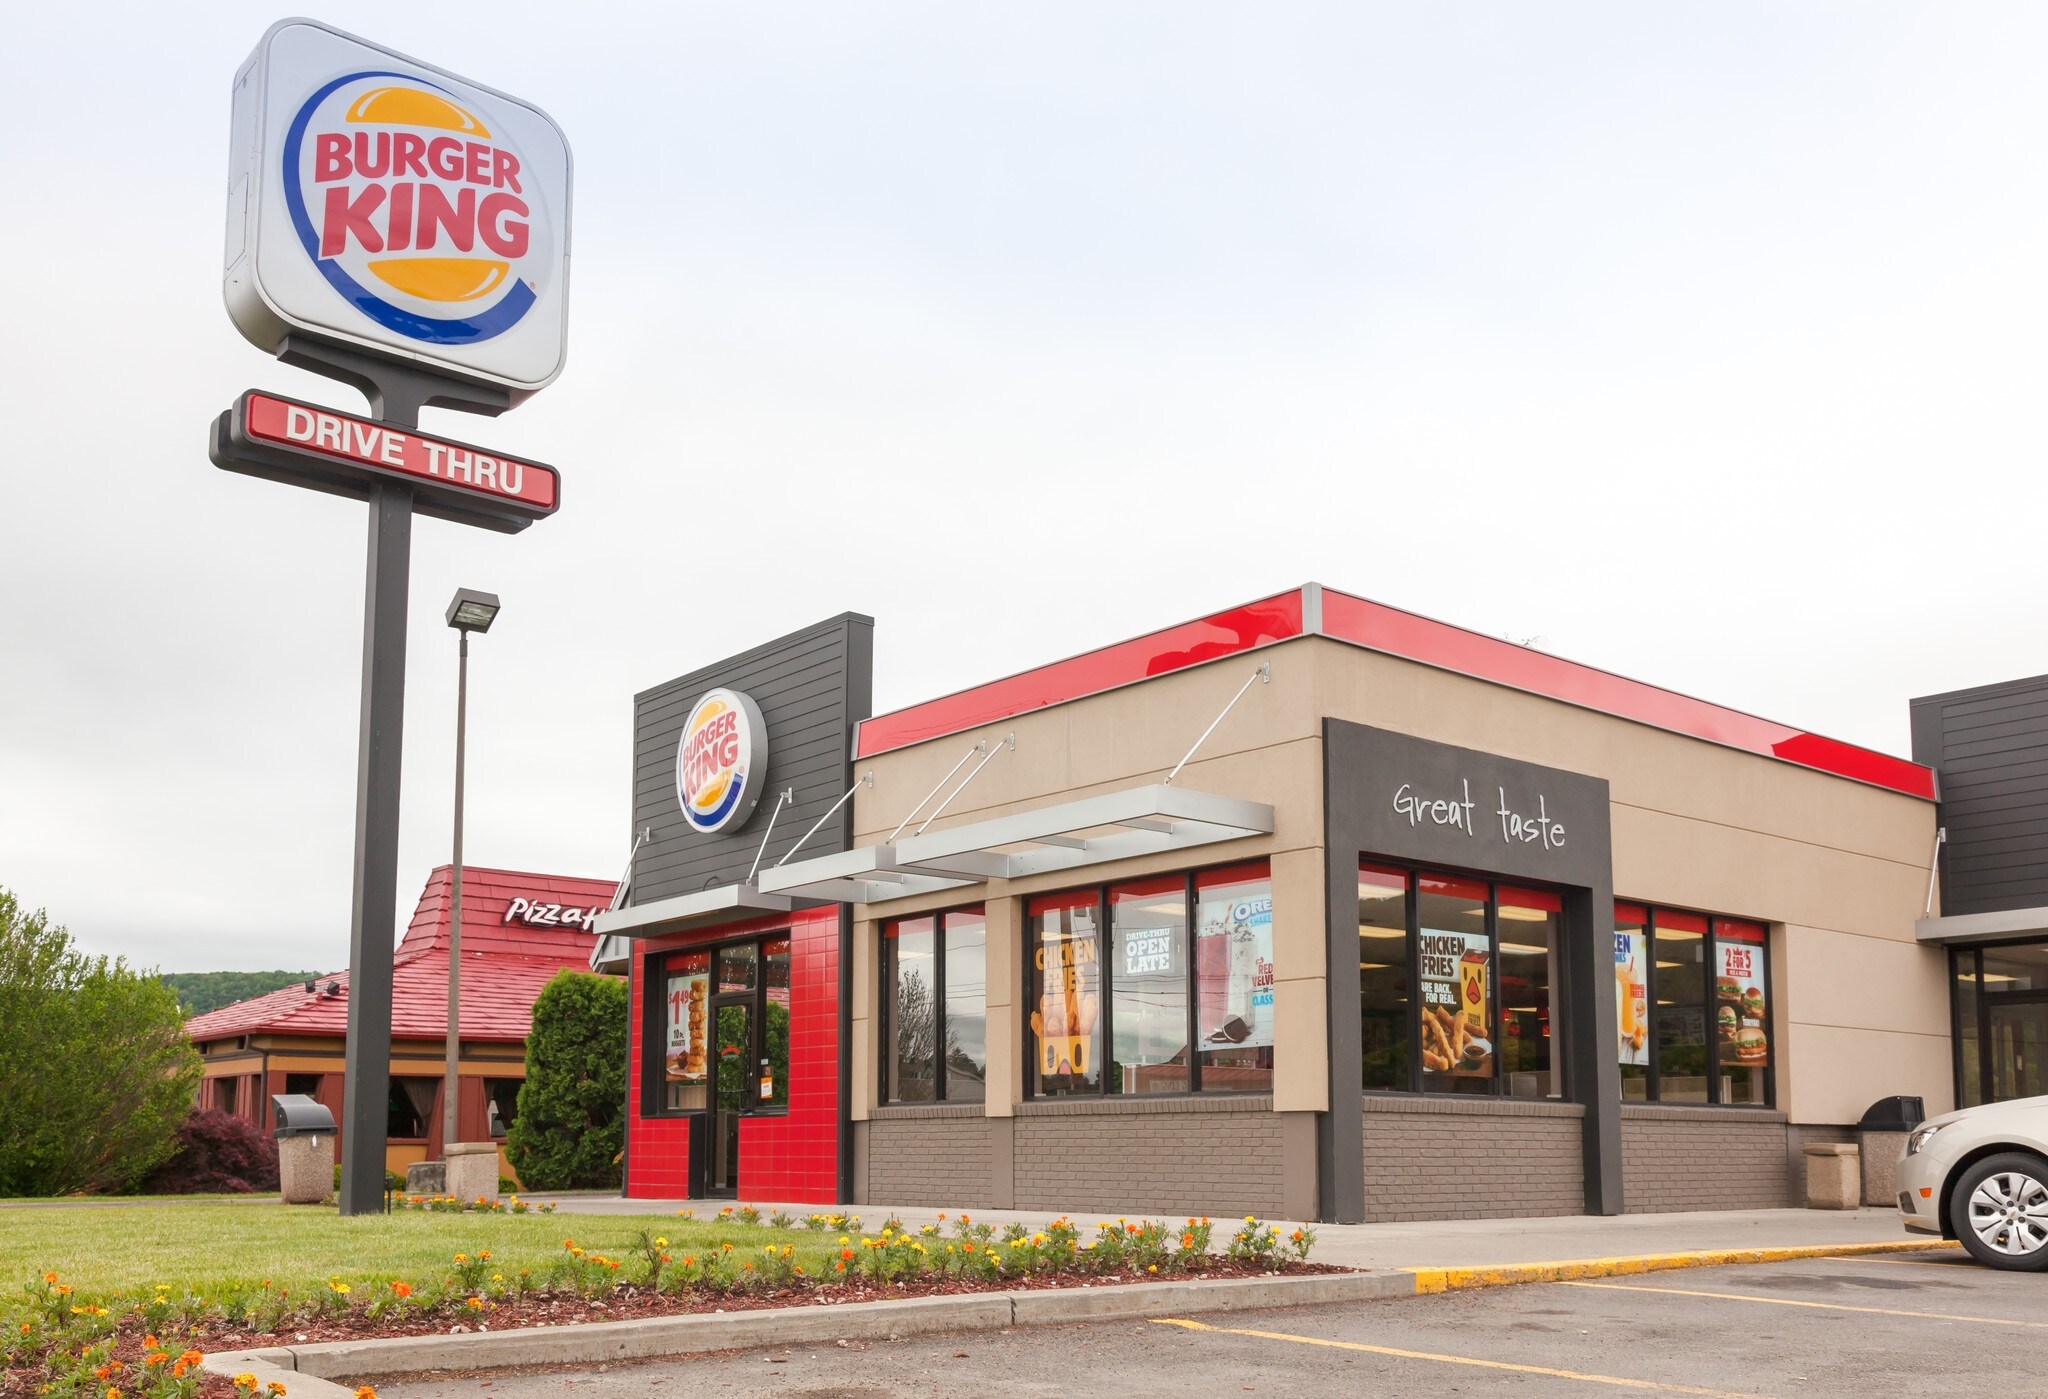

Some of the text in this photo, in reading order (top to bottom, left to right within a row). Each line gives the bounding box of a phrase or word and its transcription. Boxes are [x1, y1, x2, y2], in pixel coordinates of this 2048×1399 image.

[315, 131, 522, 194] BURGER
[321, 182, 529, 259] KING
[286, 405, 523, 495] DRIVE THRU
[683, 710, 736, 771] BURGER
[685, 732, 739, 806] KING
[1393, 778, 1566, 851] Great taste
[506, 897, 582, 925] Pizza
[1126, 928, 1170, 941] DRIVE-THRU
[1126, 936, 1170, 957] OPEN
[1035, 939, 1095, 971] CHICKEN
[1126, 953, 1170, 974] LATE
[1258, 963, 1273, 975] RED
[1422, 955, 1454, 977] FRIES
[1726, 948, 1732, 968] 2
[1044, 965, 1085, 993] FRIES
[1434, 983, 1452, 994] BACK.
[1426, 993, 1457, 1005] FOR REAL.
